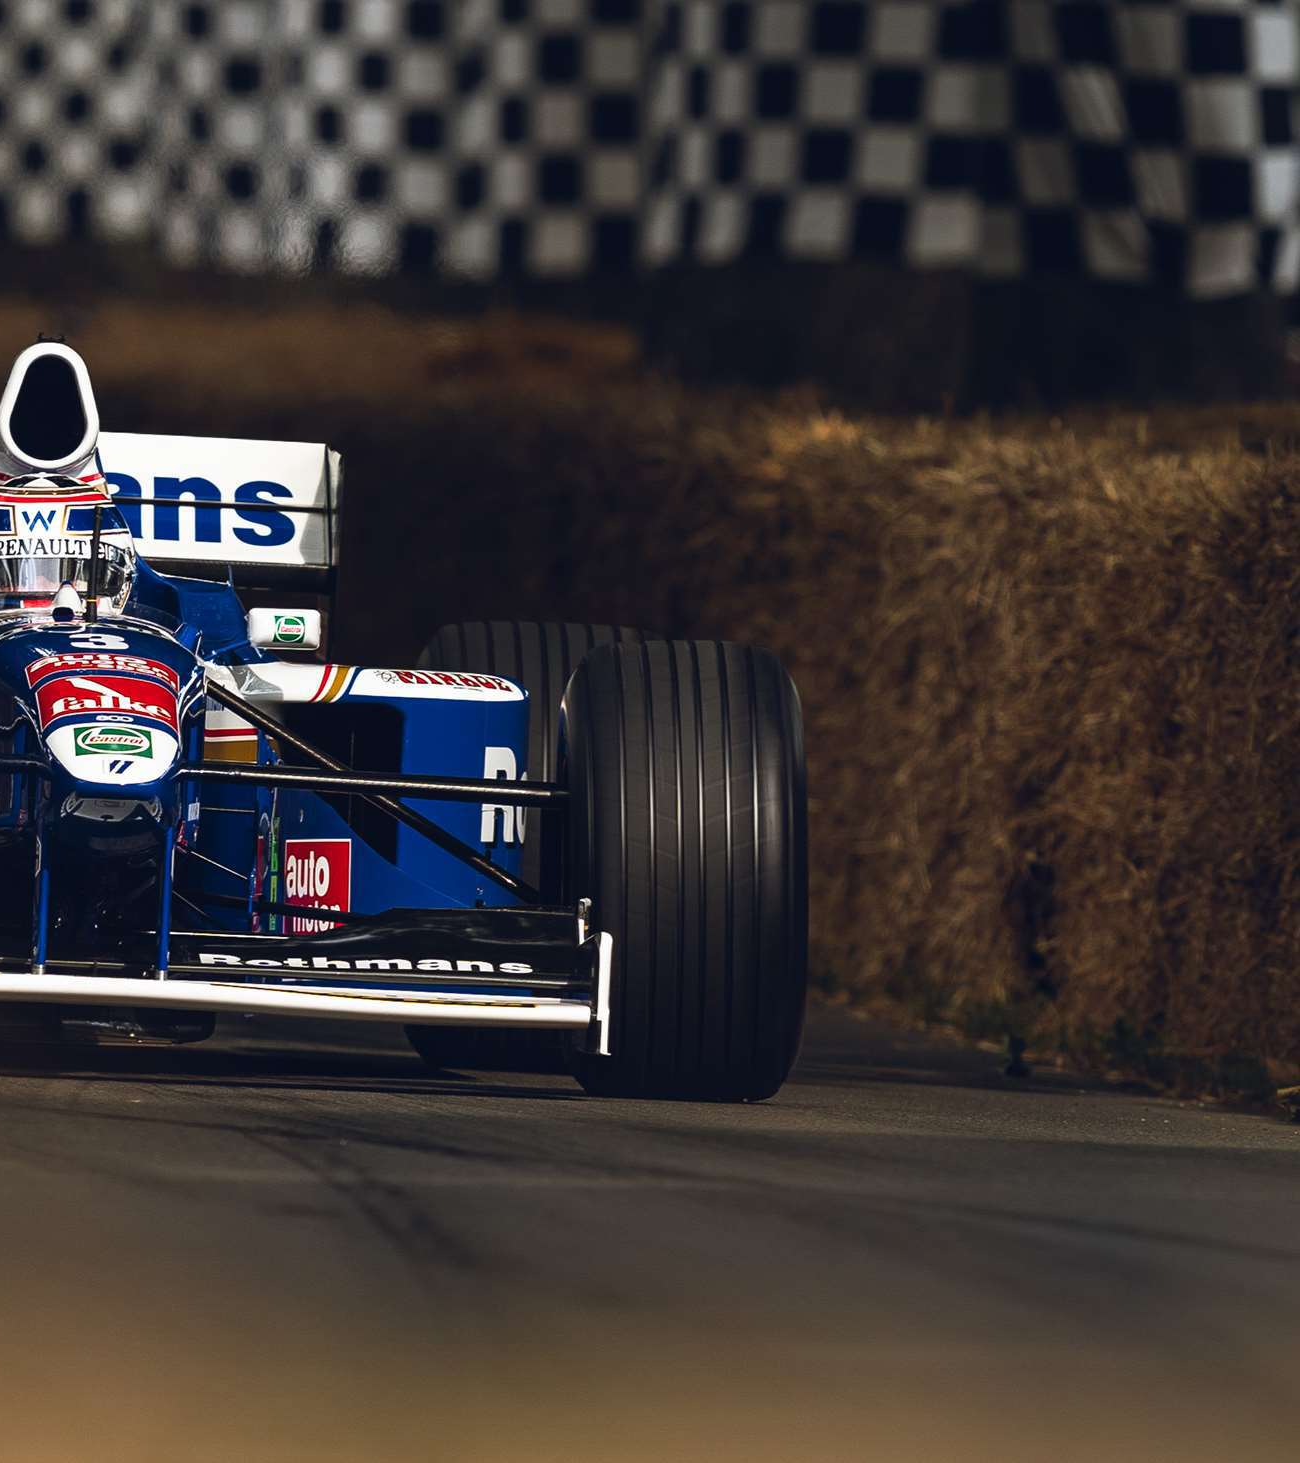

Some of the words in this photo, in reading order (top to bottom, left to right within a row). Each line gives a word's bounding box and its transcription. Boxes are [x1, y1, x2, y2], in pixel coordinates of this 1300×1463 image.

[69, 633, 130, 650] 3
[390, 671, 513, 692] MIRAGE
[52, 694, 172, 720] falke
[89, 735, 144, 745] Castrol
[286, 850, 330, 898] auto
[199, 953, 533, 974] Rothmans
